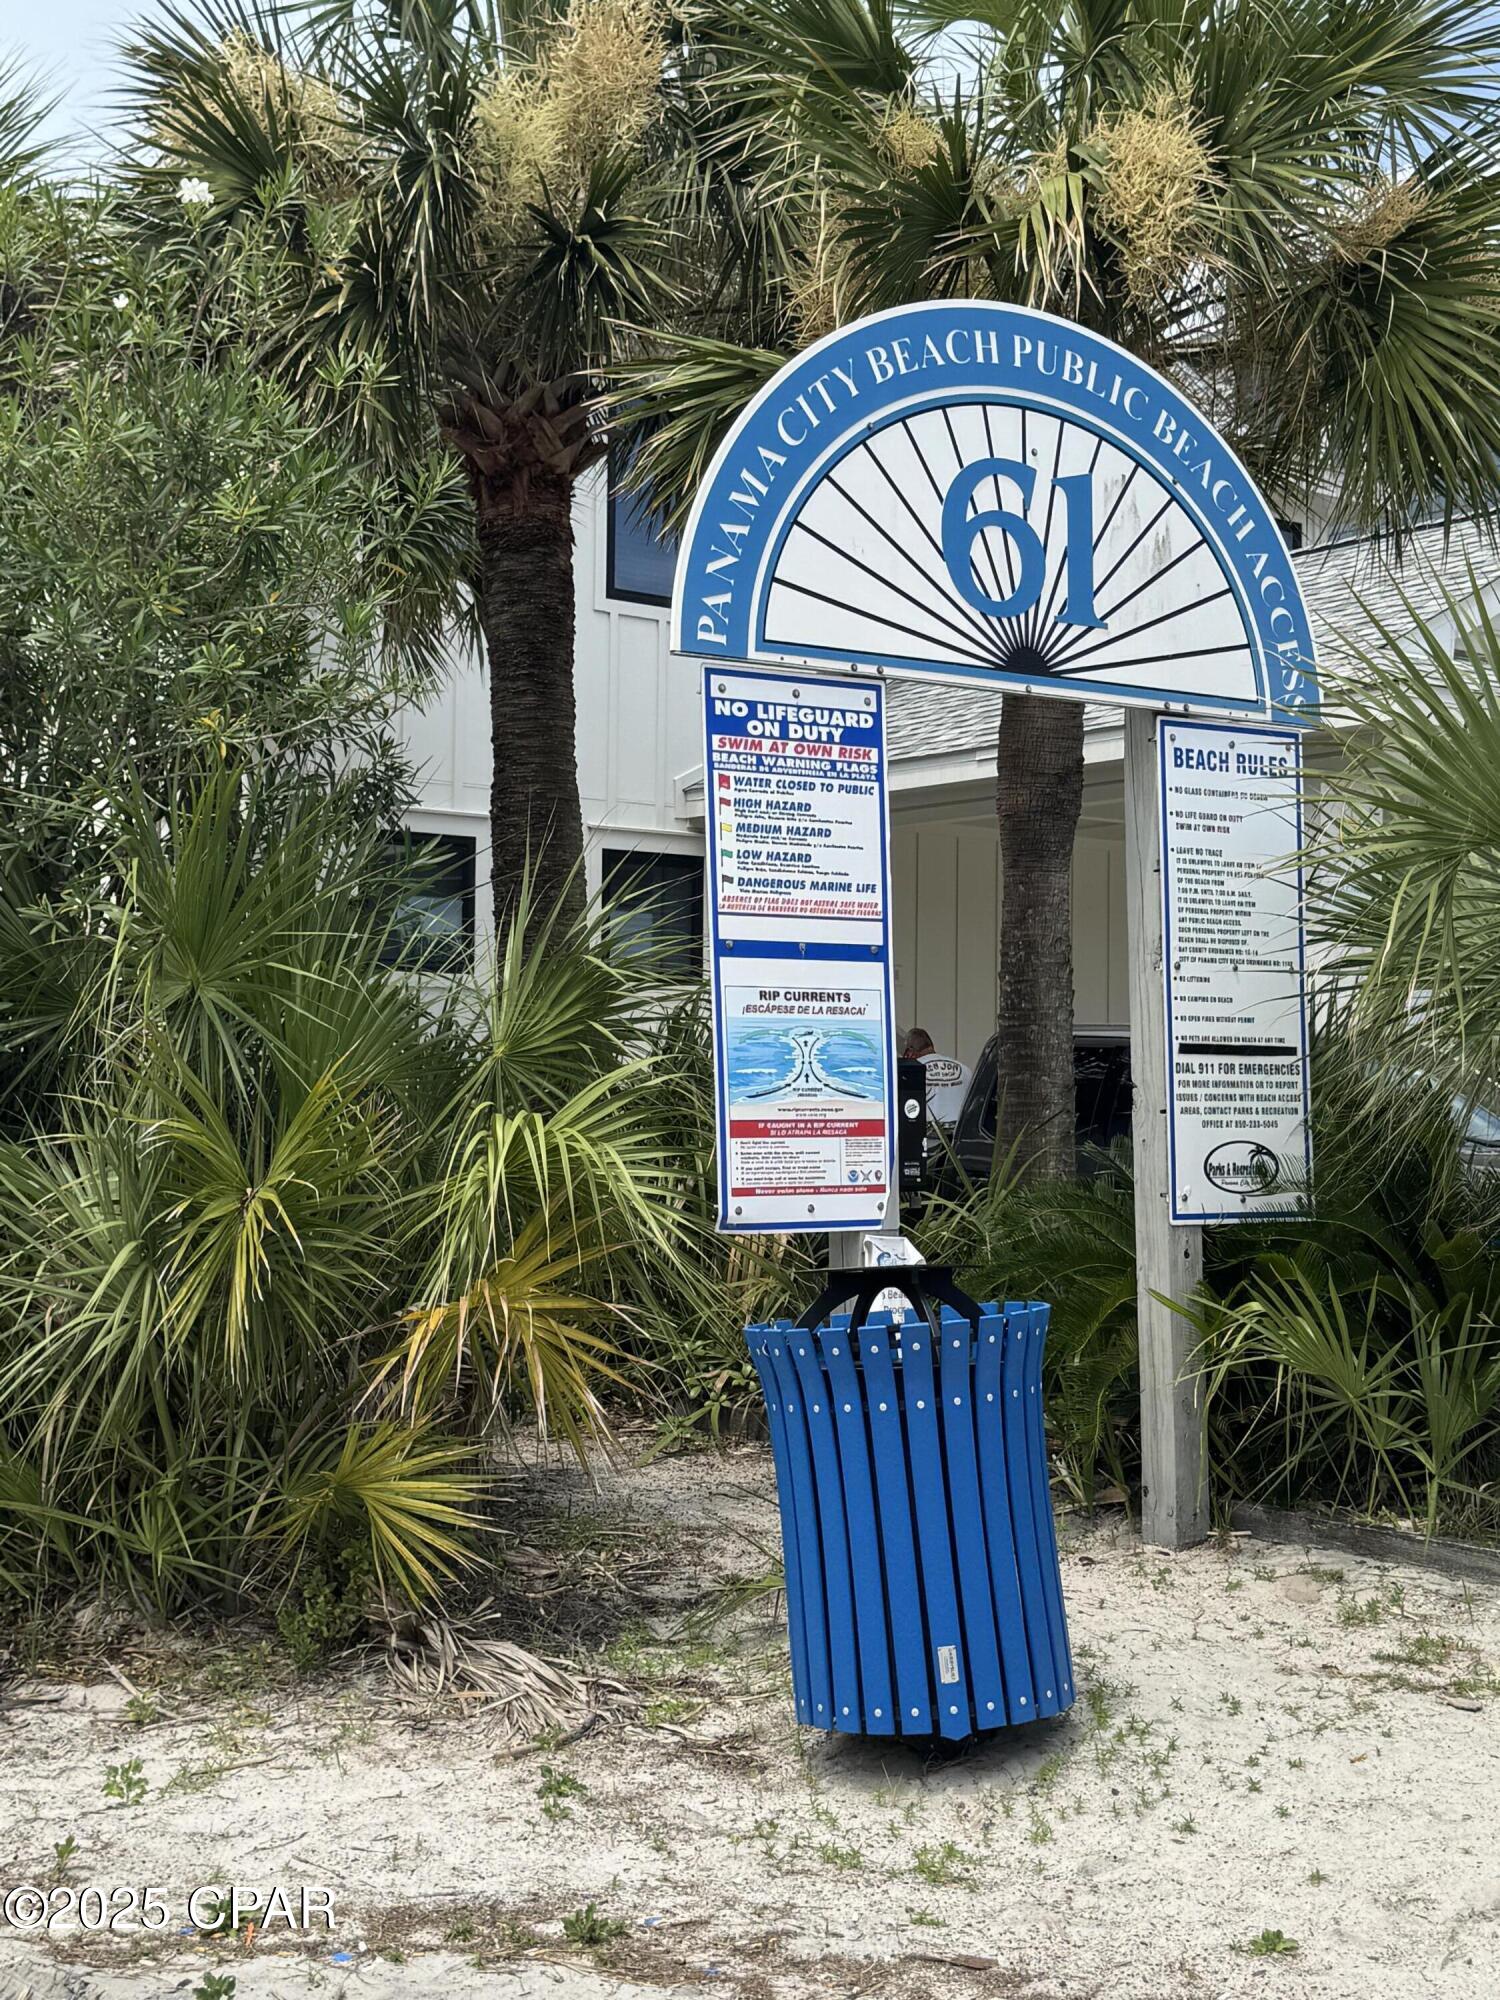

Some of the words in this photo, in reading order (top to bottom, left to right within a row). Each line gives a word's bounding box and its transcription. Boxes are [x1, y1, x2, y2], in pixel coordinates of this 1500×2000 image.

[697, 446, 787, 646] PANAMA
[776, 358, 860, 446] CITY
[865, 329, 1000, 384] BEACH
[1012, 334, 1149, 421] PUBLIC
[1152, 409, 1256, 542] BEACH
[942, 458, 1108, 630] 61
[714, 700, 748, 717] NO
[757, 704, 874, 728] LIFEGUARD
[747, 720, 780, 737] ON
[788, 724, 845, 742] DUTY
[718, 736, 762, 752] SWIM
[768, 742, 788, 754] AT
[794, 743, 832, 758] OWN
[838, 748, 873, 760] RISK
[712, 752, 758, 764] BEACH
[762, 757, 831, 770] WARNING
[836, 762, 878, 774] FLAGS
[1174, 747, 1229, 772] BEACH
[1236, 753, 1288, 776] RULES
[734, 776, 772, 788] WATER
[776, 778, 816, 791] CLOSED
[820, 783, 834, 792] TO
[838, 784, 874, 796] PUBLIC
[1175, 786, 1183, 794] NO
[1184, 787, 1202, 796] GLASS
[734, 798, 761, 809] HIGH
[766, 800, 812, 812] HAZARD
[1185, 811, 1196, 819] LIFE
[1199, 812, 1218, 820] GUARD
[1229, 814, 1243, 822] DUTY
[736, 822, 782, 834] MEDIUM
[786, 826, 832, 838] HAZARD
[1217, 826, 1230, 834] RISK
[736, 850, 762, 860] LOW
[766, 852, 812, 863] HAZARD
[1176, 847, 1194, 855] LEAVE
[1205, 848, 1223, 857] TRACE
[738, 877, 806, 890] DANGEROUS
[810, 882, 853, 892] MARINE
[856, 883, 877, 894] LIFE
[760, 990, 780, 1001] RIP
[784, 991, 851, 1002] CURRENTS
[798, 1006, 810, 1014] DE
[812, 1006, 824, 1014] LA
[1176, 1062, 1196, 1074] DIAL
[1198, 1063, 1214, 1074] 911
[1218, 1063, 1236, 1075] FOR
[1239, 1063, 1300, 1076] EMERGENCIES
[1178, 1080, 1190, 1088] FOR
[1192, 1080, 1210, 1088] MORE
[1212, 1080, 1254, 1089] INFORMATION
[1275, 1081, 1298, 1089] REPORT
[1176, 1093, 1198, 1101] ISSUES
[1204, 1093, 1237, 1102] CONCERNS
[1238, 1094, 1255, 1102] WITH
[1256, 1094, 1276, 1102] BEACH
[1278, 1094, 1301, 1102] ACCESS
[1180, 1106, 1202, 1116] AREAS,
[1204, 1107, 1232, 1115] CONTACT
[1261, 1107, 1299, 1115] RECREATION
[1202, 1120, 1224, 1128] OFFICE
[1225, 1120, 1233, 1128] AT
[1209, 1162, 1226, 1176] Parks
[1226, 1162, 1231, 1176] &
